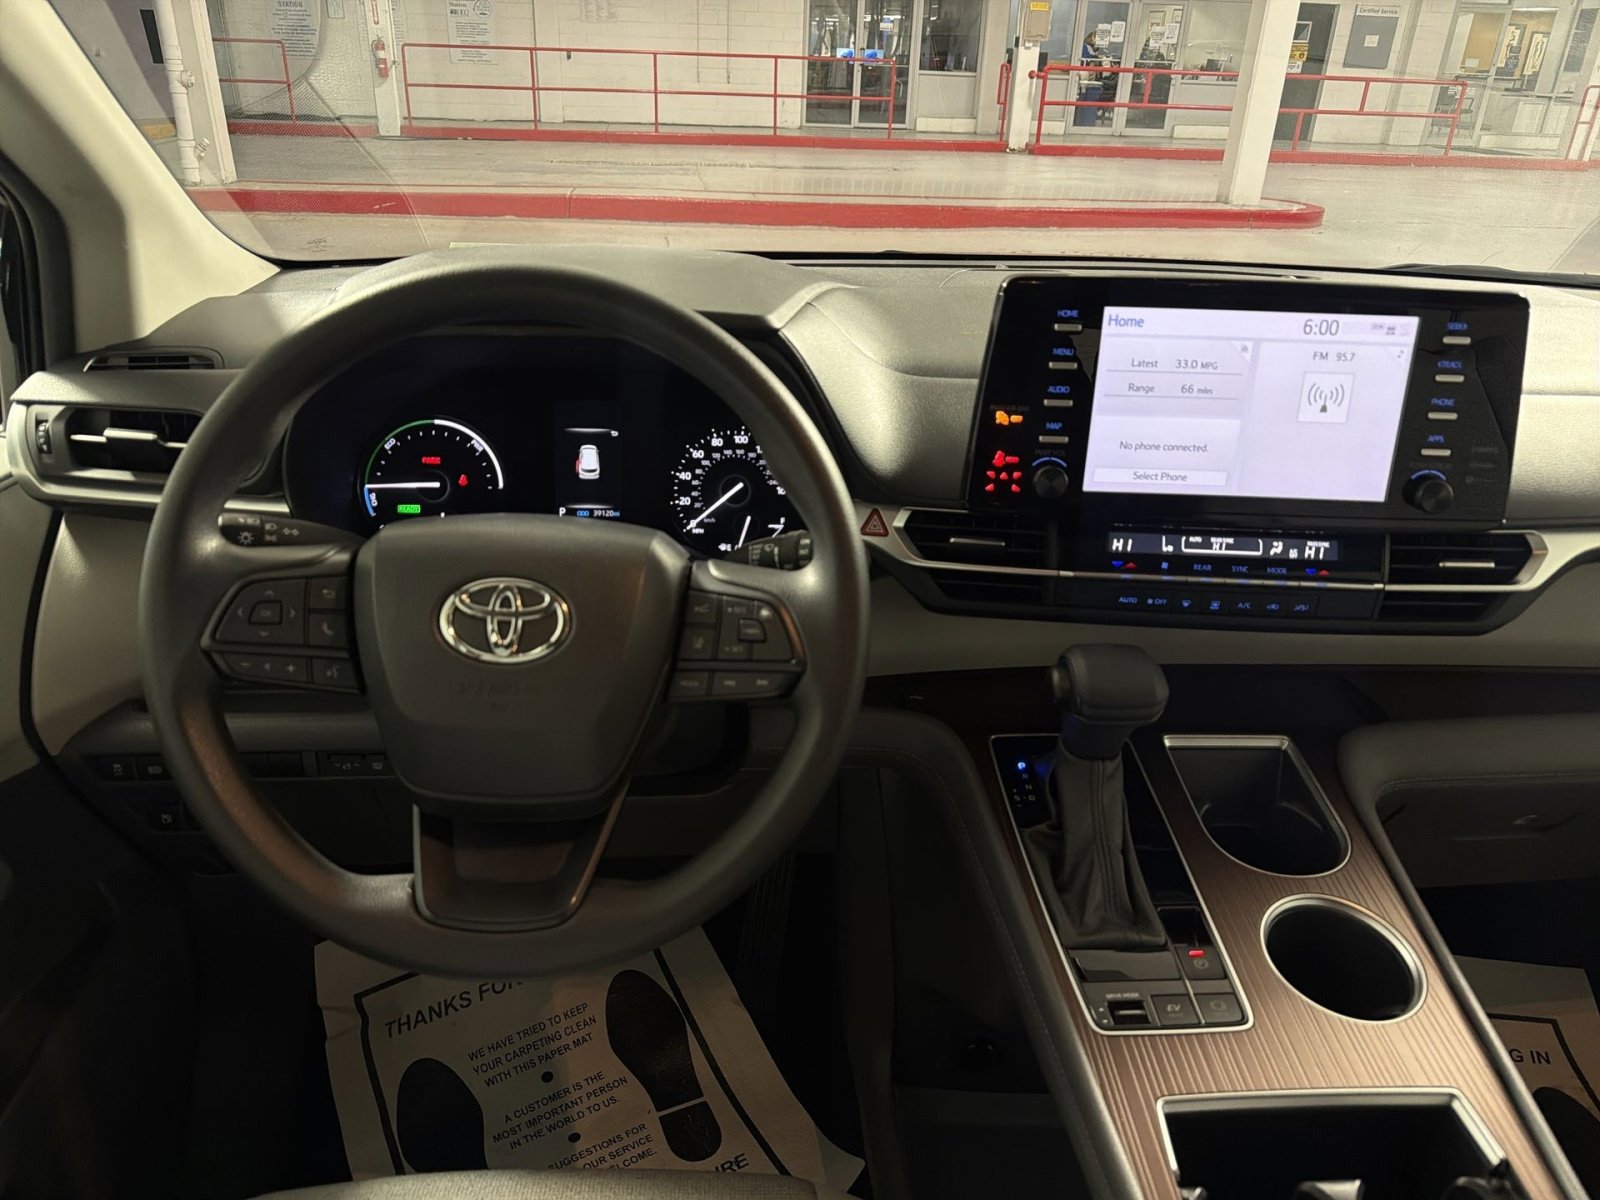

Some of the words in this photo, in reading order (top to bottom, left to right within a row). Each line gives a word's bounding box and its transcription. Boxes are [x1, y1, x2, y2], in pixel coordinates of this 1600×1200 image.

[1108, 314, 1144, 328] Home
[1303, 319, 1340, 336] 6:00
[1313, 352, 1328, 361] FM
[1336, 352, 1356, 362] 95.7
[1132, 359, 1158, 368] Latest
[1175, 360, 1198, 370] 33.0
[1200, 362, 1218, 370] MPG
[1128, 383, 1155, 394] Range
[1181, 384, 1194, 394] 66
[1197, 387, 1214, 395] miles
[1046, 422, 1063, 430] MAP
[711, 438, 724, 446] 80
[734, 436, 748, 444] 100
[1120, 441, 1134, 450] No
[1135, 442, 1161, 453] phone
[1162, 442, 1208, 453] connected.
[692, 450, 704, 458] 60
[679, 472, 692, 480] 40
[1133, 472, 1160, 482] Select
[1161, 472, 1188, 482] Phone
[680, 497, 691, 506] 20
[559, 506, 566, 517] P
[1112, 538, 1132, 552] HI
[384, 990, 472, 1038] THANKS
[479, 982, 522, 1002] FO
[468, 1047, 486, 1062] WE
[488, 1035, 514, 1054] HAVE
[516, 1022, 546, 1044] TRIED
[547, 1013, 562, 1026] TO
[563, 1002, 589, 1019] KEEP
[473, 1057, 504, 1076] YOUR
[504, 1028, 563, 1066] CARPETING
[564, 1015, 597, 1036] CLEAN
[484, 1071, 512, 1088] WITH
[514, 1058, 537, 1076] THIS
[538, 1044, 571, 1064] PAPER
[570, 1032, 594, 1048] MAT
[1530, 1050, 1551, 1064] IN
[504, 1114, 512, 1124] A
[513, 1086, 572, 1120] CUSTOMER
[573, 1081, 584, 1091] IS
[584, 1071, 606, 1087] THE
[492, 1124, 523, 1144] MOST
[524, 1096, 584, 1130] IMPORTANT
[585, 1076, 628, 1104] PERSON
[509, 1138, 522, 1150] IN
[523, 1129, 546, 1146] THE
[546, 1111, 586, 1136] WORLD
[586, 1103, 602, 1117] TO
[602, 1096, 620, 1110] US.
[625, 1123, 647, 1138] FOR
[583, 1155, 606, 1169] OUR
[608, 1134, 654, 1160] SERVICE
